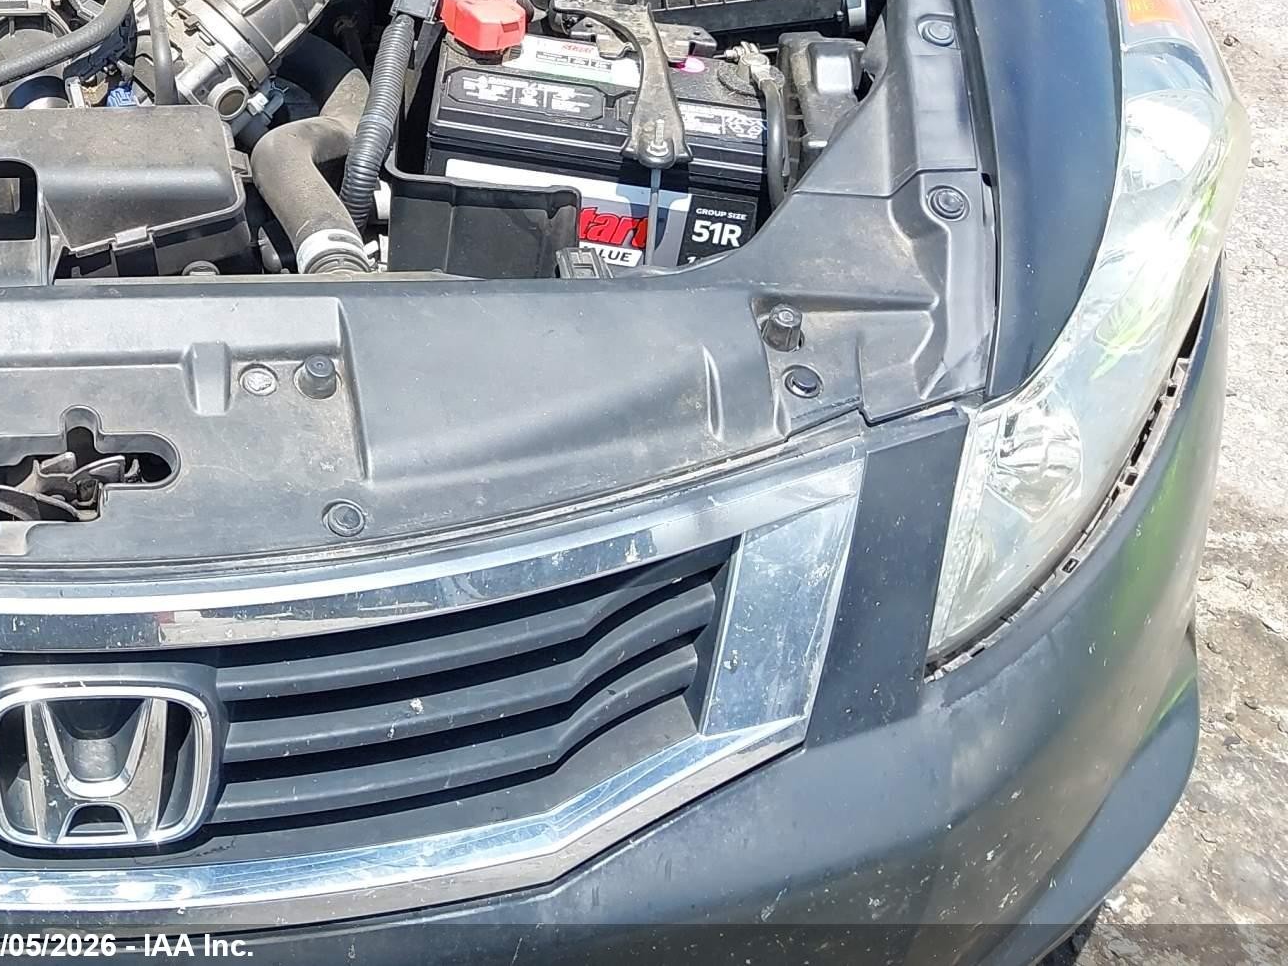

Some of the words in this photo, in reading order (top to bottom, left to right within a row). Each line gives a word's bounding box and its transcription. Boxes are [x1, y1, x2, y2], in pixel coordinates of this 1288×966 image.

[695, 208, 727, 217] GROUP
[727, 212, 748, 221] SIZE
[578, 206, 649, 249] tart
[691, 219, 742, 248] 51R
[596, 246, 633, 263] LUE
